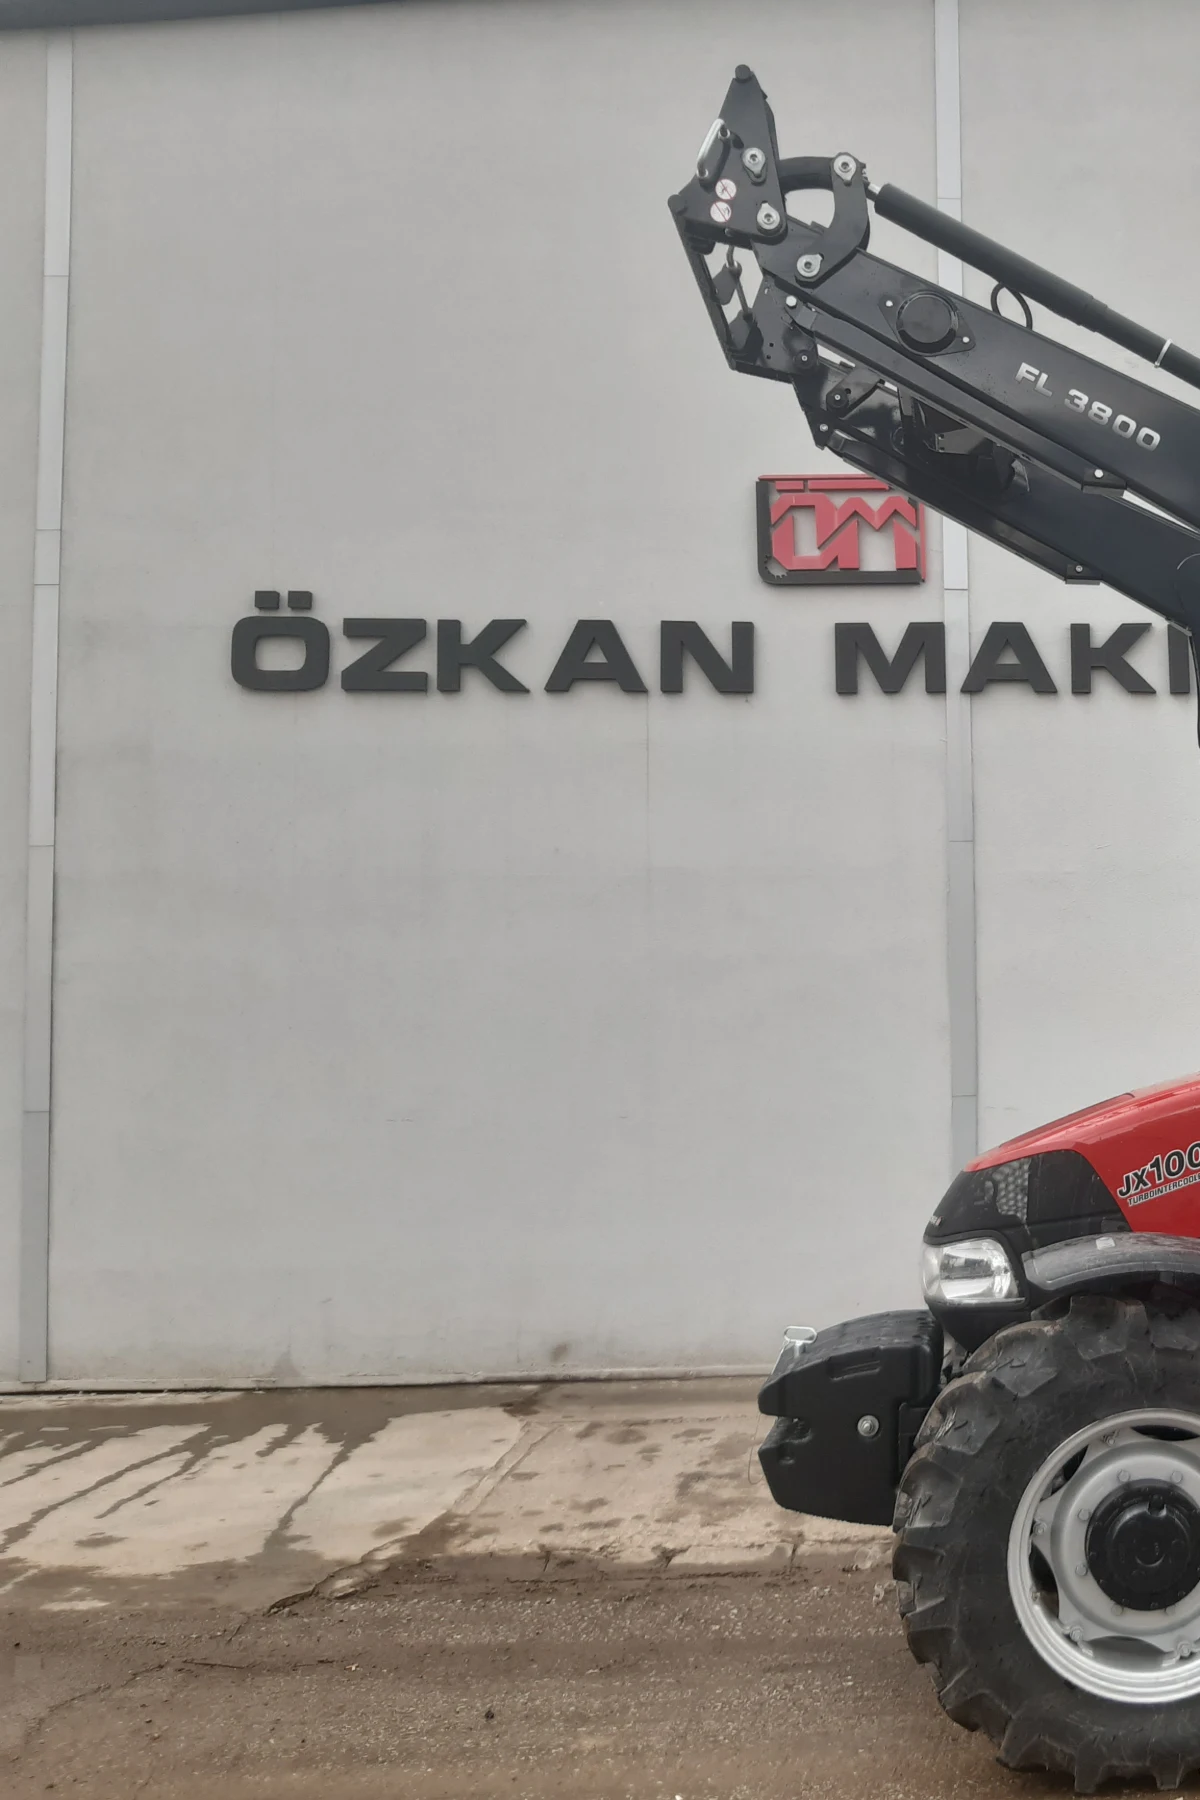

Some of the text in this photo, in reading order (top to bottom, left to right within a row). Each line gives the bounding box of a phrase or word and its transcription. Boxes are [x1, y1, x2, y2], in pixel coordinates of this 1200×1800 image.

[1015, 362, 1161, 452] FL 3800
[230, 590, 755, 694] ÖZKAN
